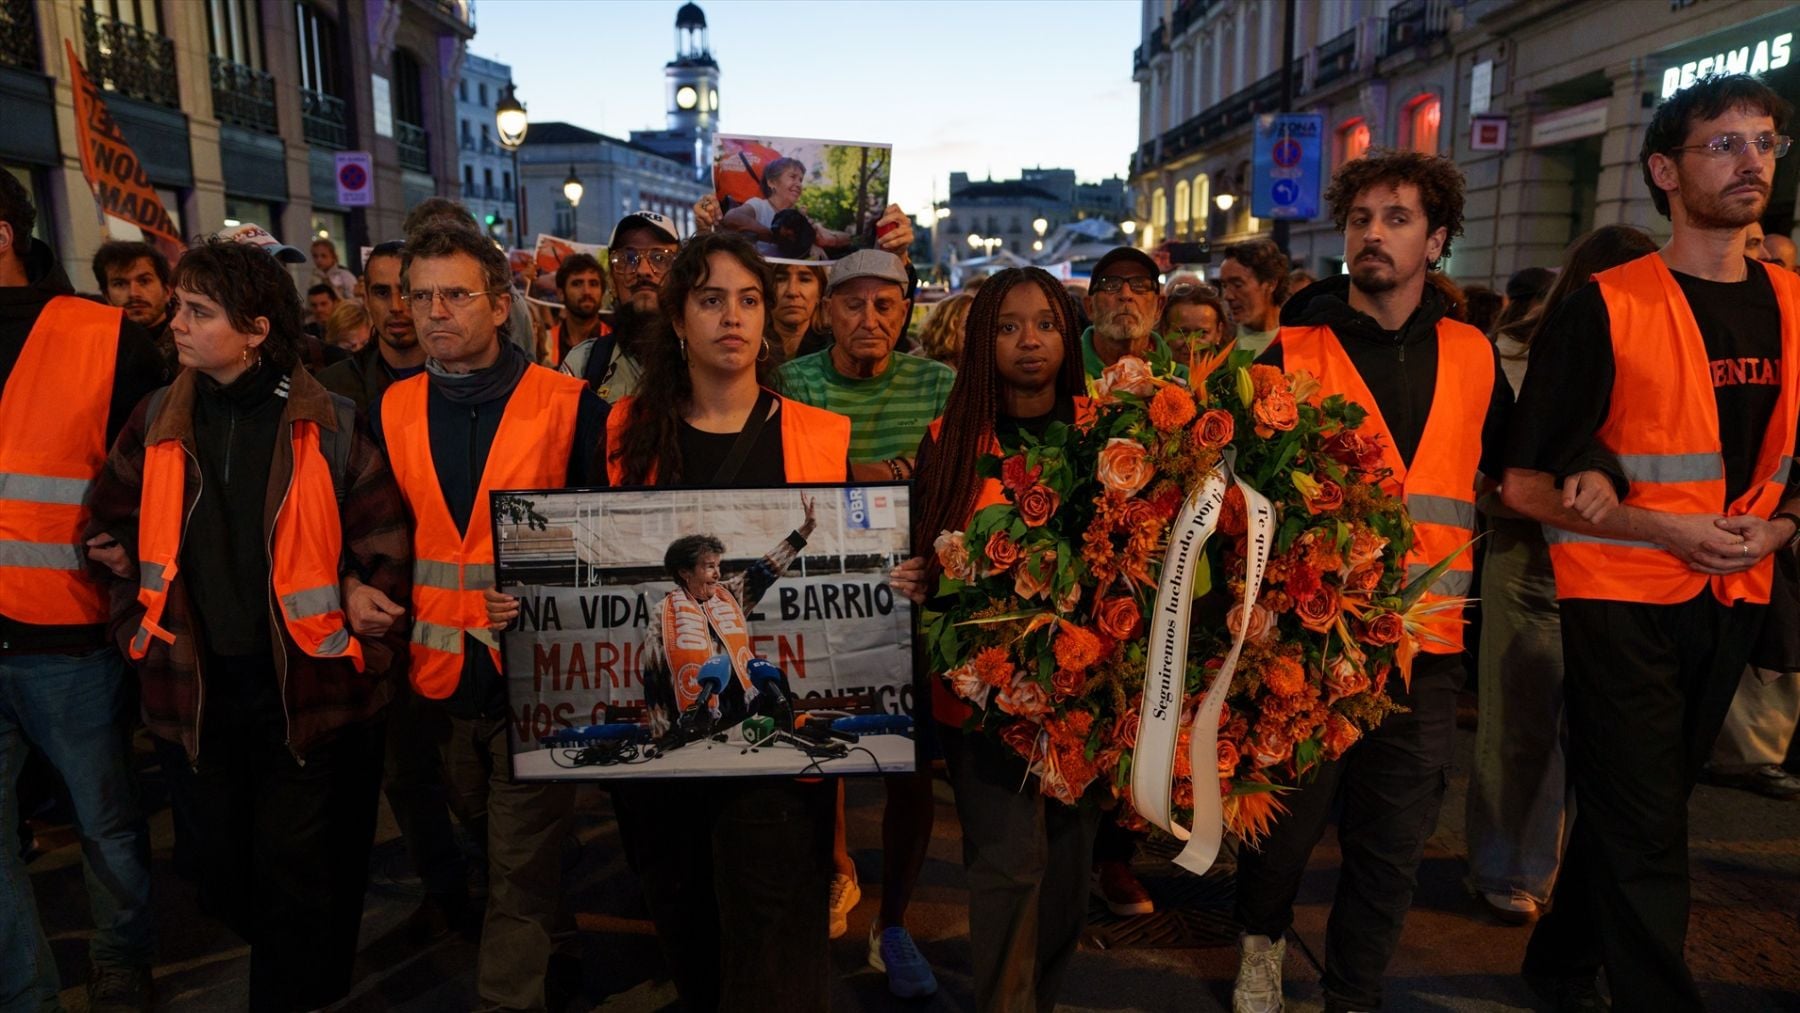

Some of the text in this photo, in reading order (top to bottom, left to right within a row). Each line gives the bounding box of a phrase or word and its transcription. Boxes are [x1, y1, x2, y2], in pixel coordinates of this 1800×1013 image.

[579, 593, 650, 630] VIDA
[779, 583, 894, 621] BARRIO
[1152, 618, 1177, 721] Seguiremos
[1165, 529, 1195, 614] luchando
[1192, 500, 1215, 528] por
